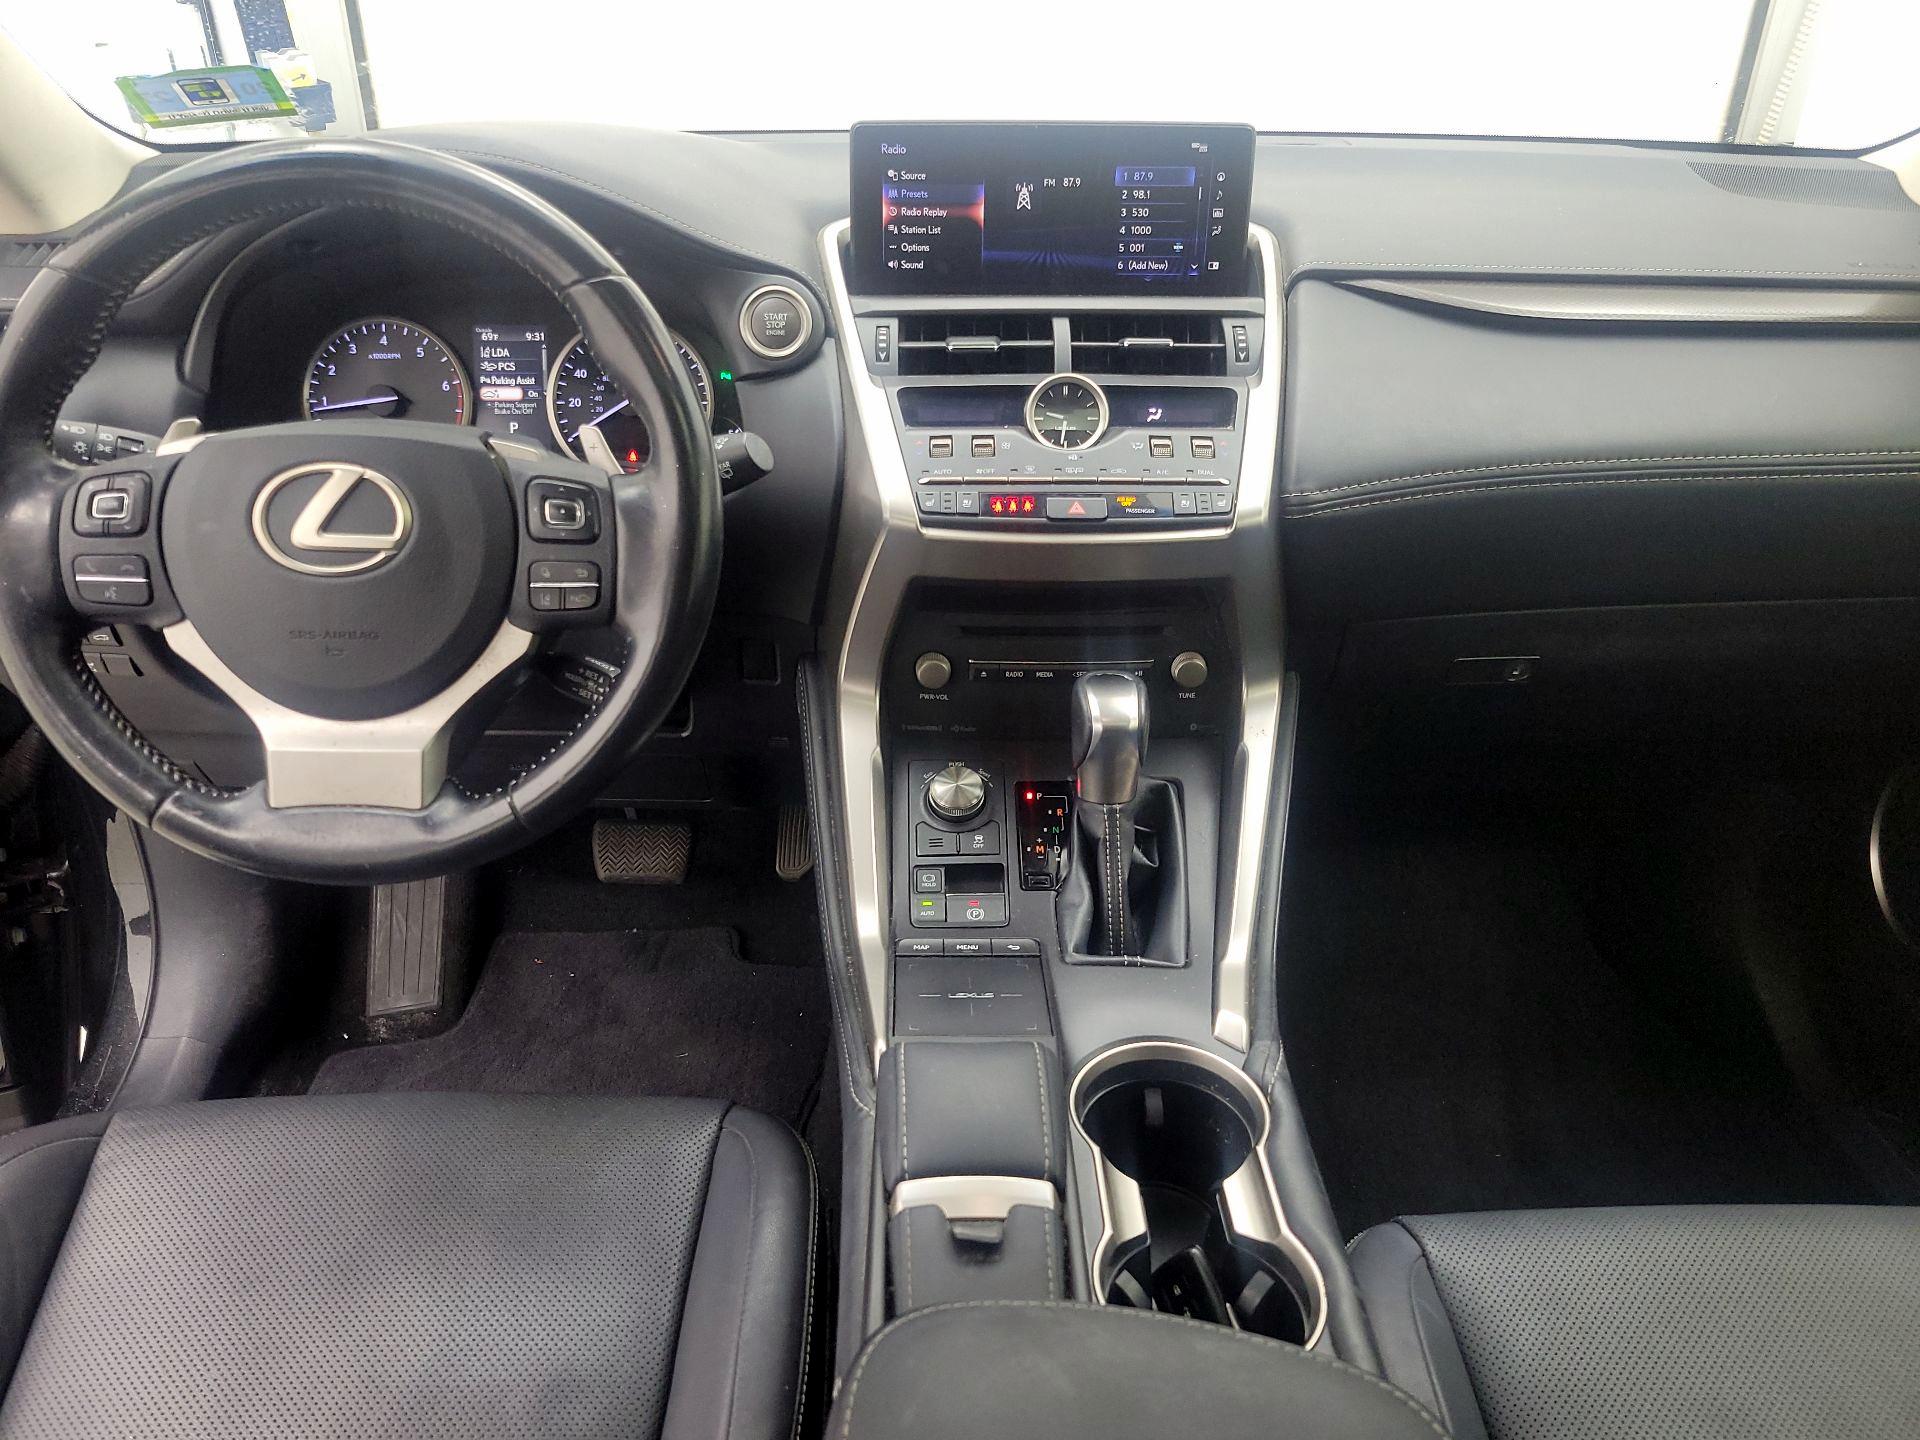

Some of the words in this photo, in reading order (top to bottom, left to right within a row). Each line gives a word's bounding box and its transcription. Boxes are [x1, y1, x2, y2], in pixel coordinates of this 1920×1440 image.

[881, 143, 906, 154] Radio
[901, 171, 926, 180] Source
[1133, 172, 1153, 181] 87.9
[1043, 178, 1056, 187] FM
[1063, 177, 1081, 187] 87.9
[901, 189, 928, 198] Presets
[1122, 190, 1128, 199] 2
[1132, 190, 1151, 199] 98.1
[901, 207, 921, 216] Radio
[923, 207, 948, 218] Replay
[1120, 208, 1127, 217] 3
[1132, 208, 1149, 217] 530
[901, 225, 927, 235] Station
[928, 225, 941, 235] List
[1119, 226, 1126, 235] 4
[1131, 226, 1152, 235] 1000
[901, 243, 930, 253] Options
[1118, 244, 1125, 252] 5
[1129, 244, 1145, 252] 001
[901, 260, 924, 270] Sound
[1117, 262, 1123, 270] 6
[1128, 261, 1147, 271] (Add
[1147, 261, 1168, 271] New)
[763, 313, 788, 321] START
[766, 321, 786, 329] STOP
[379, 335, 388, 346] 4
[525, 332, 545, 341] 9:31
[348, 345, 357, 354] 3
[416, 348, 425, 358] 5
[491, 348, 511, 358] LDA
[327, 366, 336, 376] 2
[498, 362, 516, 371] PCS
[573, 369, 588, 379] 40
[442, 381, 451, 391] 6
[491, 376, 516, 387] Parking
[516, 376, 536, 385] Assist
[528, 390, 539, 398] On
[321, 396, 328, 407] 1
[494, 402, 514, 410] Parking
[515, 402, 537, 410] Support
[568, 398, 582, 408] 20
[509, 422, 519, 434] P
[1197, 468, 1215, 476] DUAL
[1036, 792, 1043, 800] P
[1056, 808, 1064, 816] R
[1052, 826, 1060, 834] N
[1035, 845, 1045, 854] M
[1053, 845, 1061, 854] D
